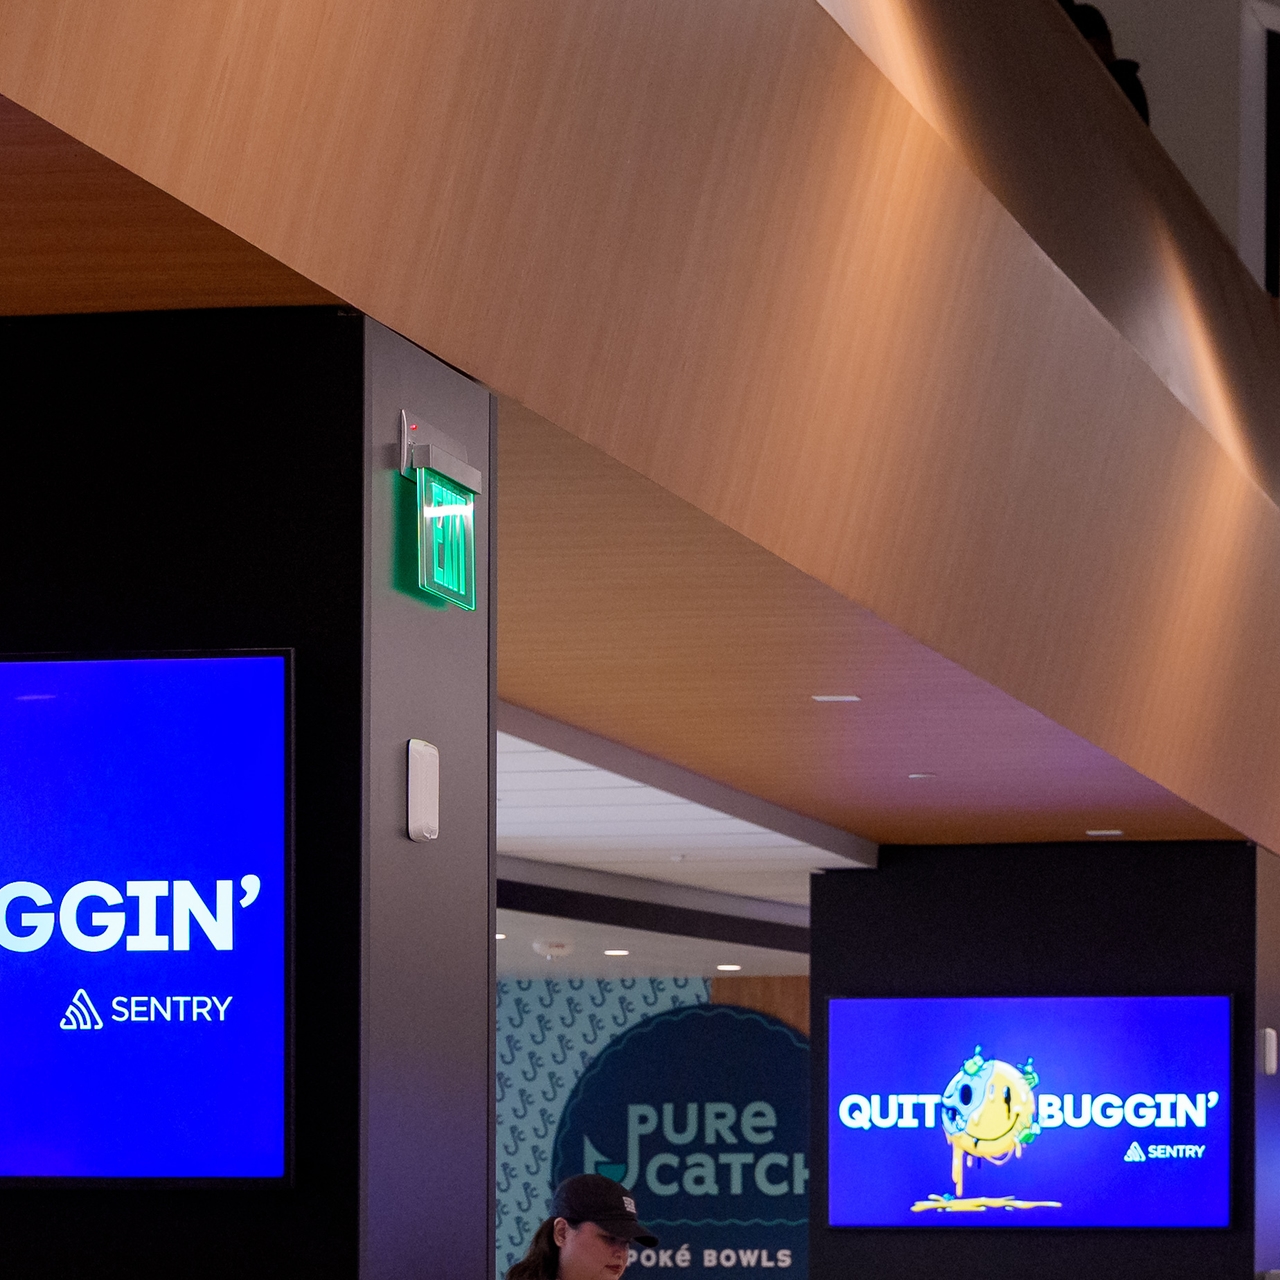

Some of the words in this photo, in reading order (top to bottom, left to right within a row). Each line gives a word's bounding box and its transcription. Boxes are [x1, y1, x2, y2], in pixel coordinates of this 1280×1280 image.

[431, 482, 466, 596] EXIT
[111, 996, 233, 1022] SENTRY
[838, 1094, 942, 1130] QUIT
[1038, 1091, 1219, 1128] BUGGIN'
[1148, 1145, 1206, 1158] SENTRY
[703, 1249, 793, 1268] BOWLS
